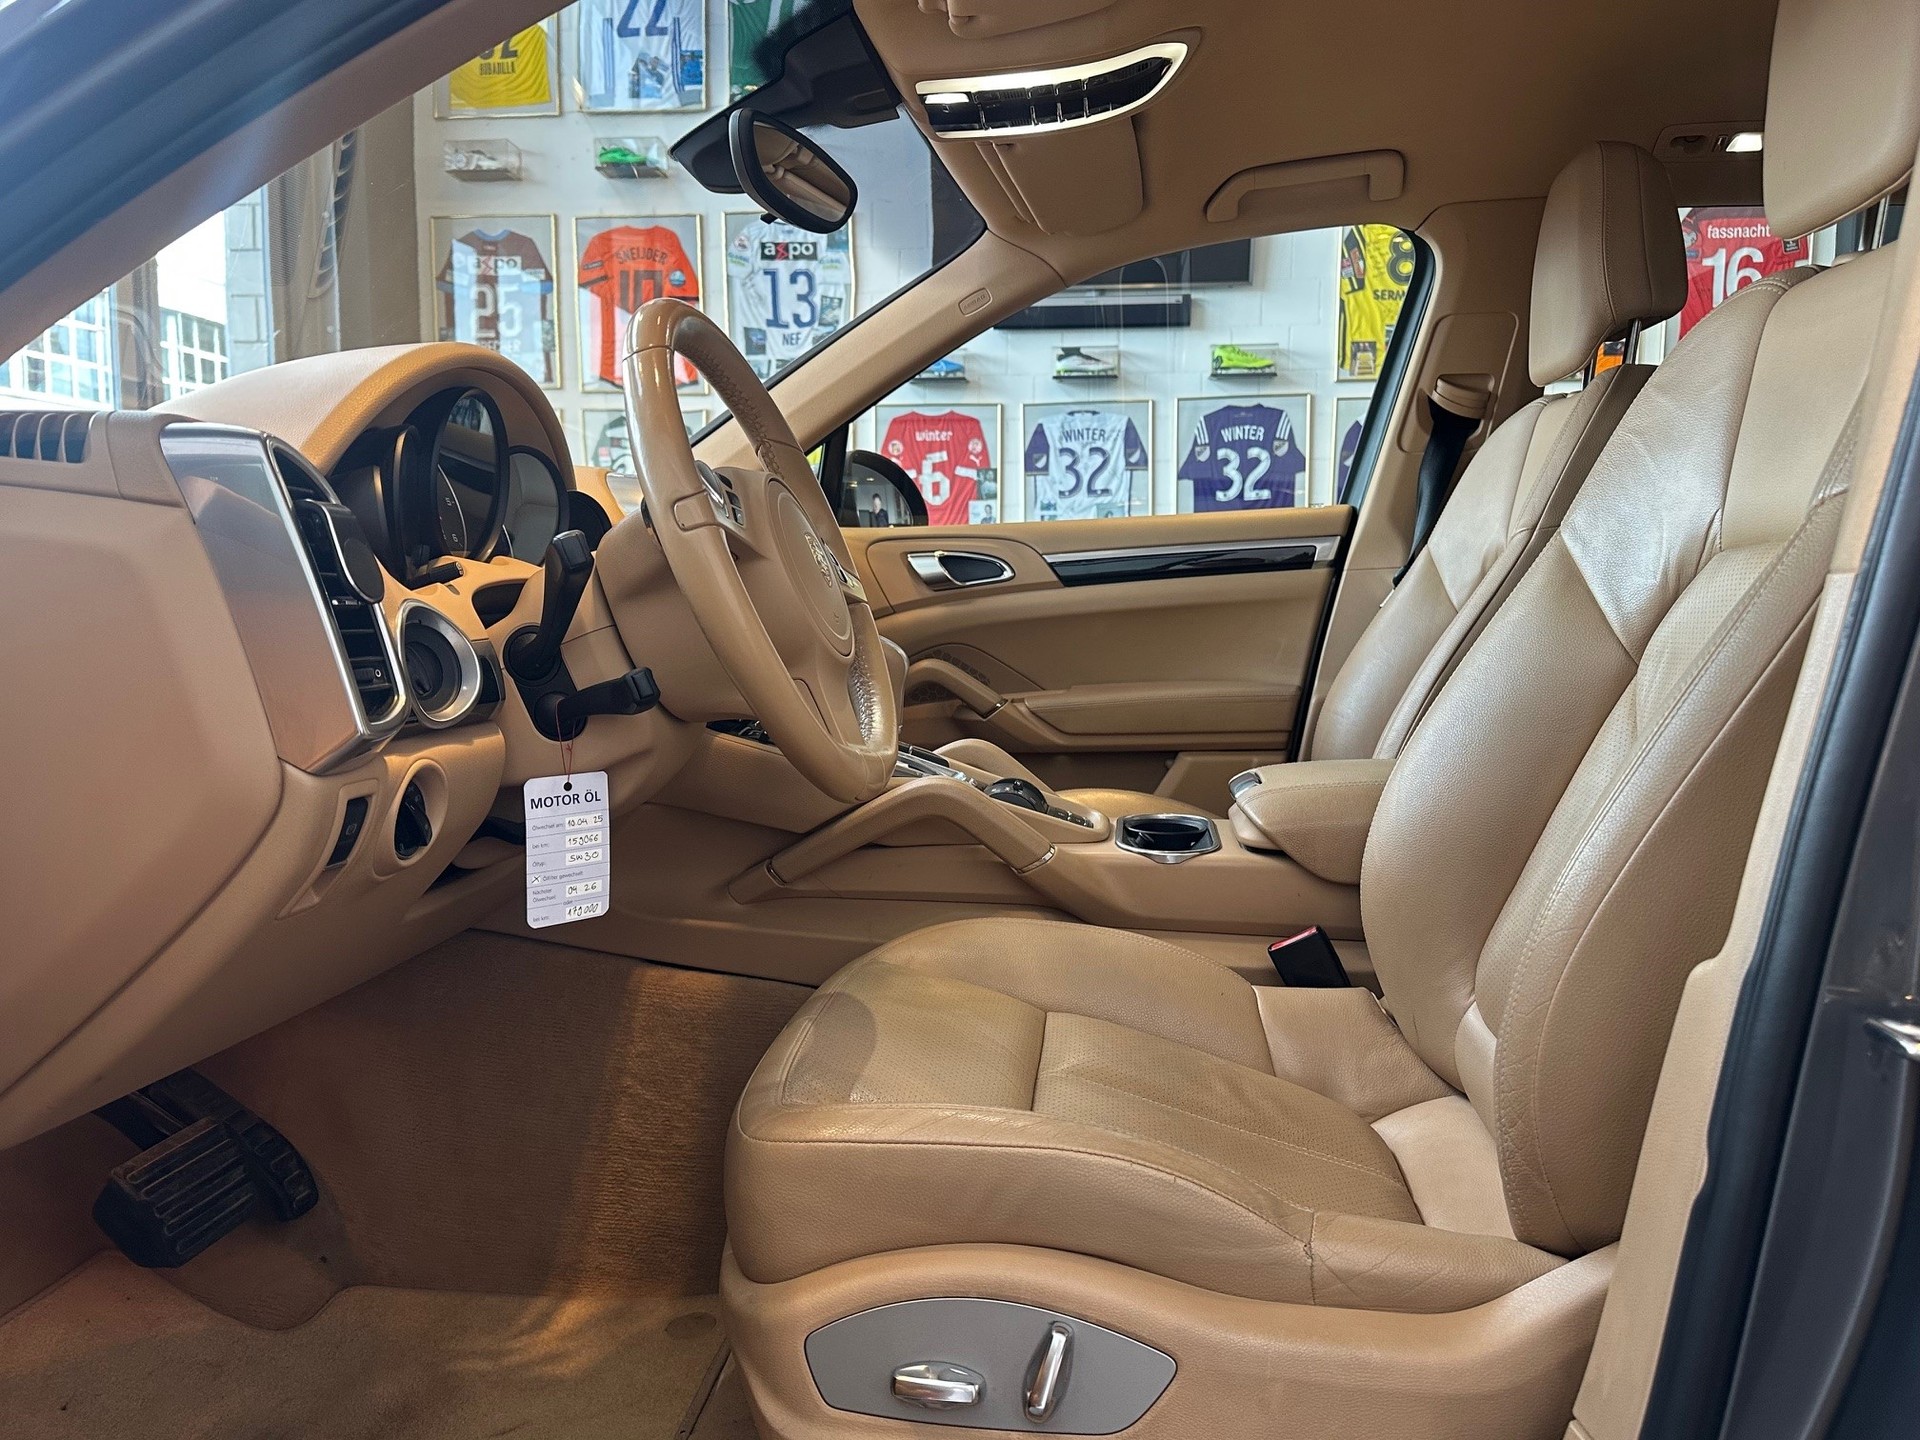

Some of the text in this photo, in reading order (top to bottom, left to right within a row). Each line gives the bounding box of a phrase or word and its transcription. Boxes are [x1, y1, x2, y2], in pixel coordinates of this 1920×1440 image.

[1707, 224, 1771, 239] fassnacht
[615, 247, 668, 265] SNEIJDER
[763, 242, 814, 261] axpo
[1386, 230, 1415, 287] 8
[619, 269, 663, 315] 10
[1702, 247, 1764, 308] 16
[469, 283, 523, 338] 25
[763, 268, 816, 329] 13
[782, 333, 802, 346] NEF
[915, 429, 954, 442] winter
[1062, 428, 1106, 443] WINTER
[1221, 425, 1265, 442] WINTER
[921, 450, 950, 505] 6
[1058, 446, 1111, 499] 32
[1216, 447, 1272, 501] 32
[530, 789, 601, 809] MOTOR ÖL
